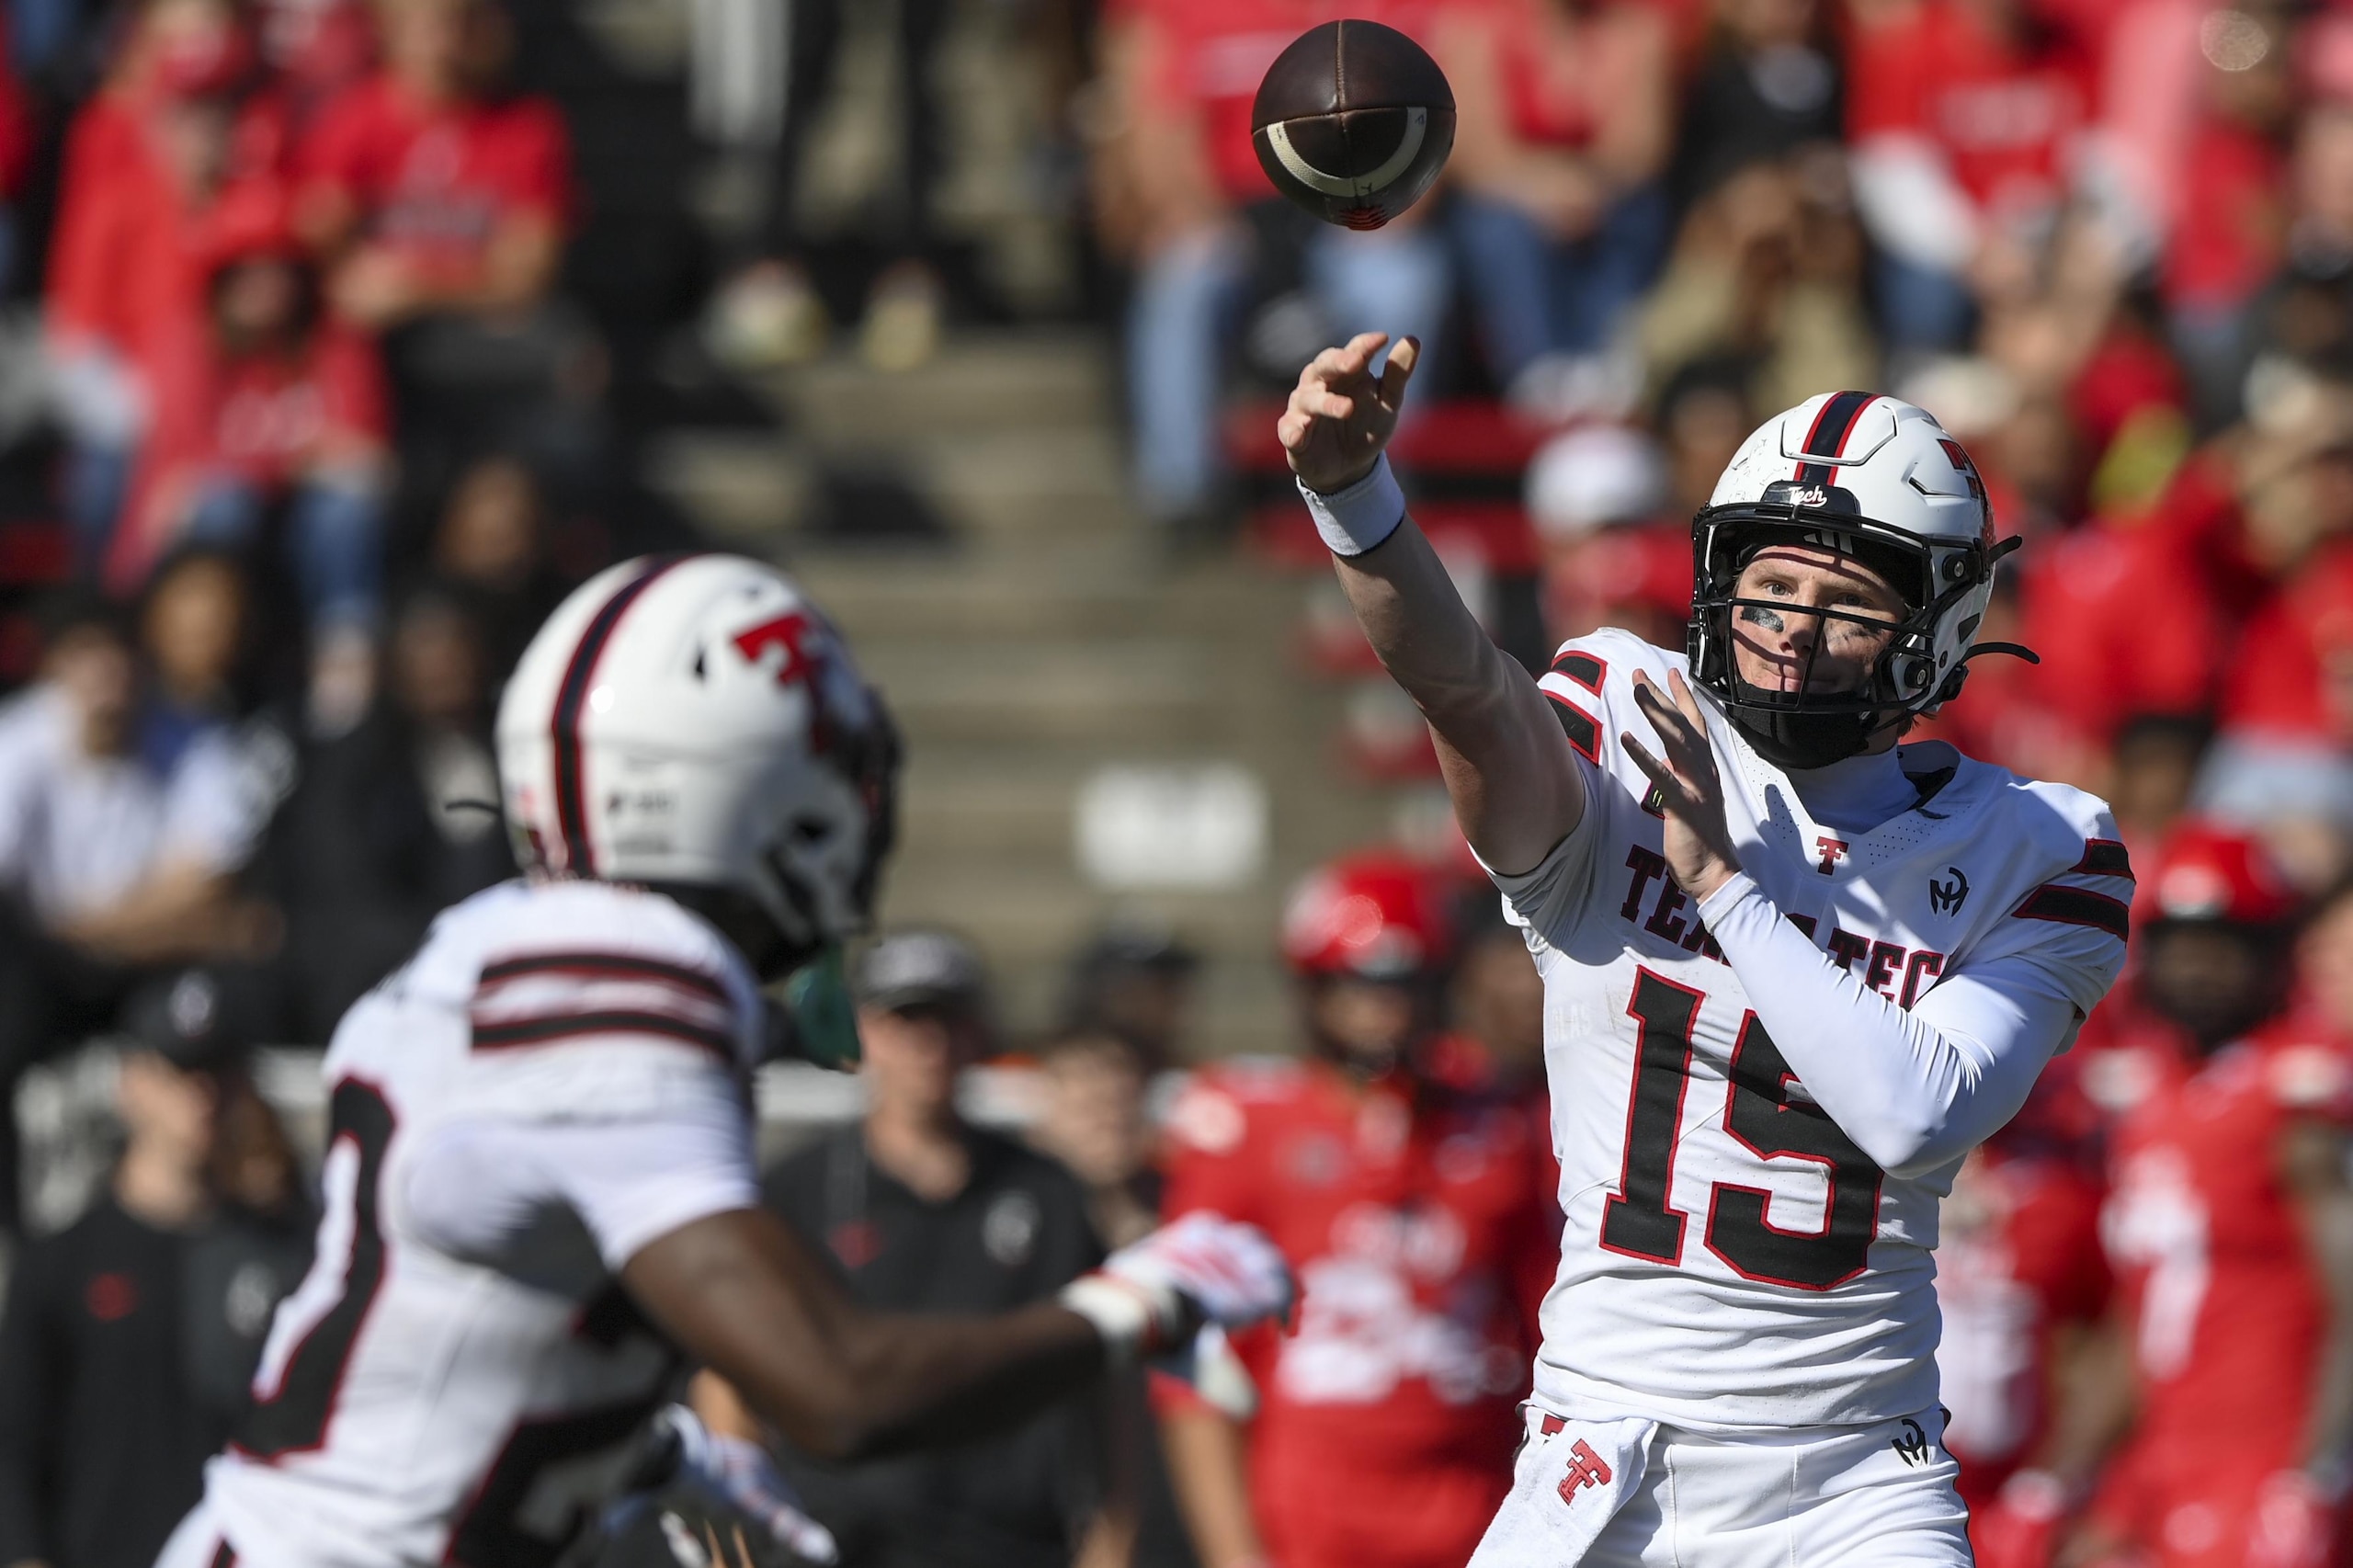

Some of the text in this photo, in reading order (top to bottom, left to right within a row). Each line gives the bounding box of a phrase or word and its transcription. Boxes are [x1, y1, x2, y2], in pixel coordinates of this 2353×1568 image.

[1788, 484, 1827, 507] Tech
[1828, 926, 1955, 1013] TEC
[1599, 964, 1884, 1291] 15
